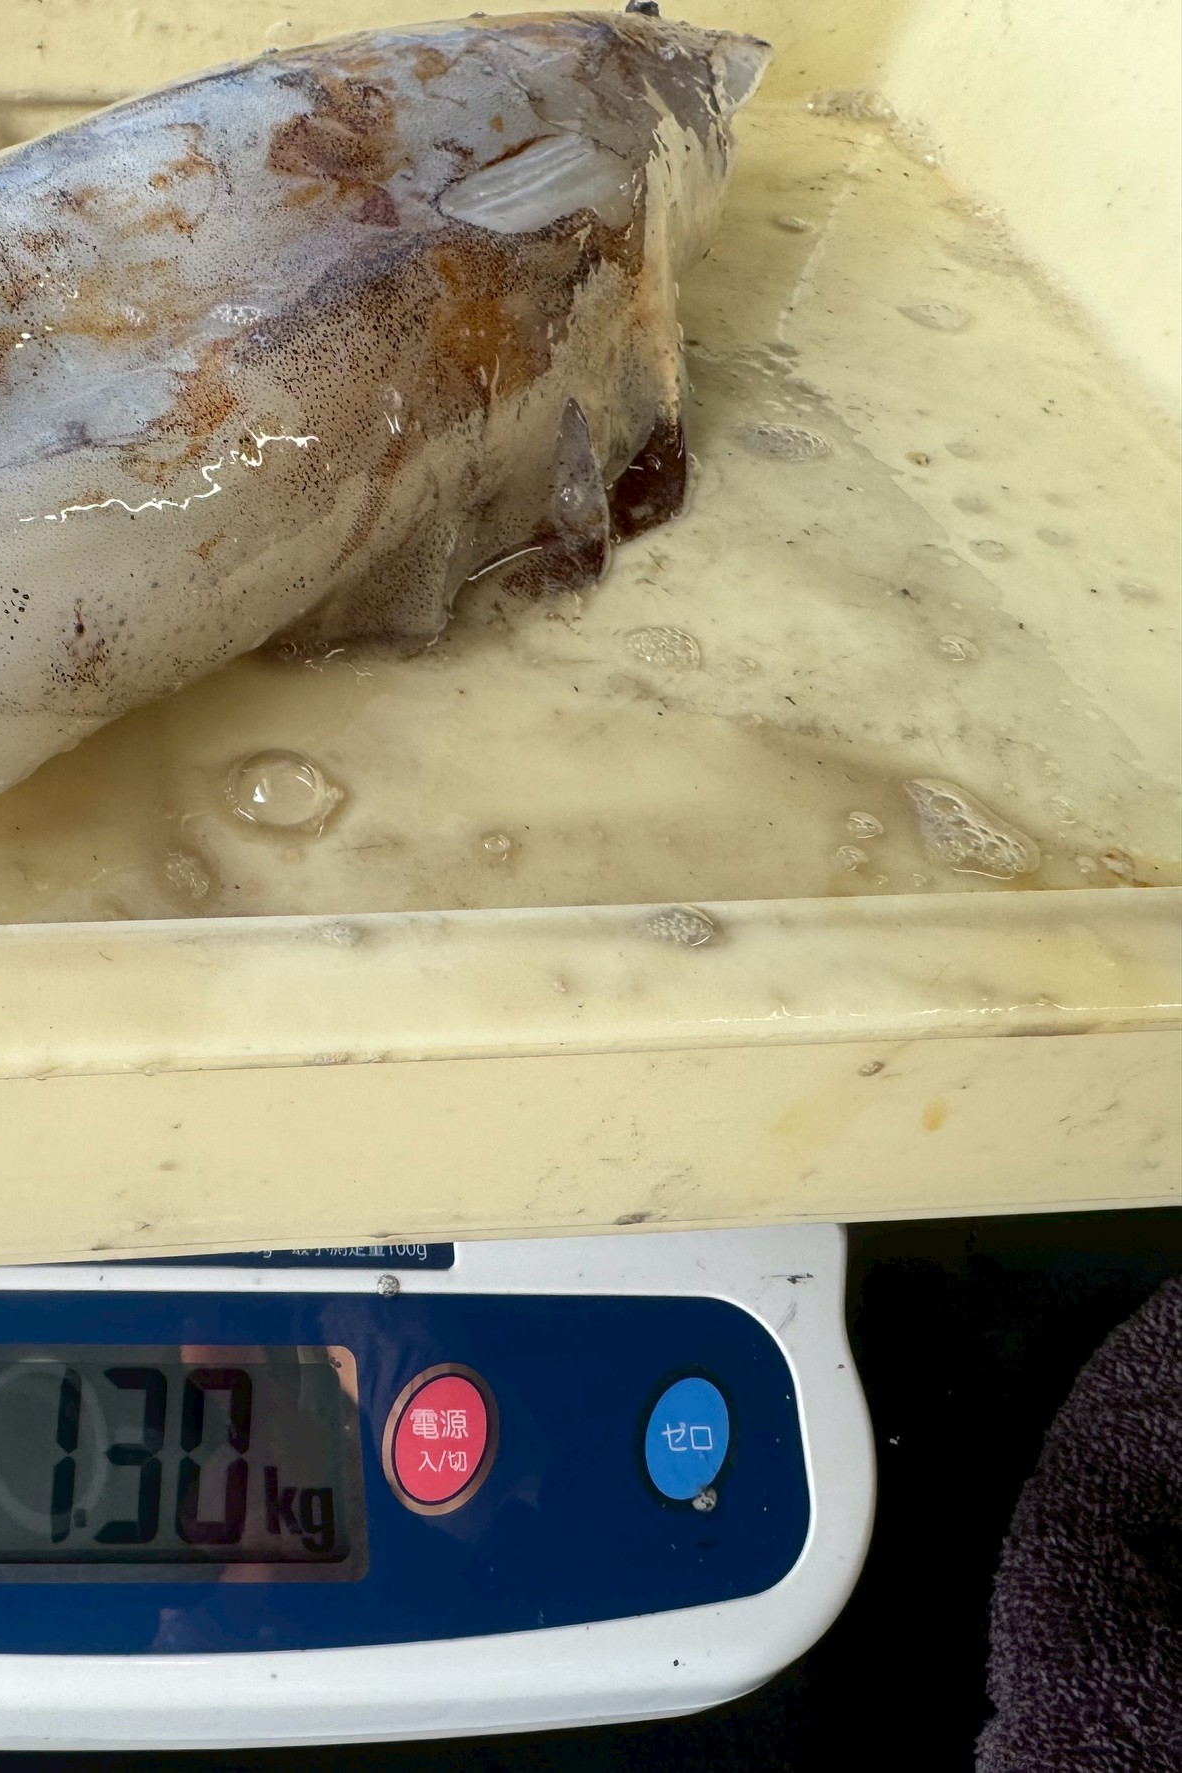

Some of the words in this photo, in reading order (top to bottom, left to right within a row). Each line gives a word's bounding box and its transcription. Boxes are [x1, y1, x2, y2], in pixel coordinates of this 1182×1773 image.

[410, 1408, 469, 1440] 電源
[661, 1421, 714, 1452] ゼロ
[418, 1450, 467, 1473] 入/切
[264, 1466, 334, 1552] kg
